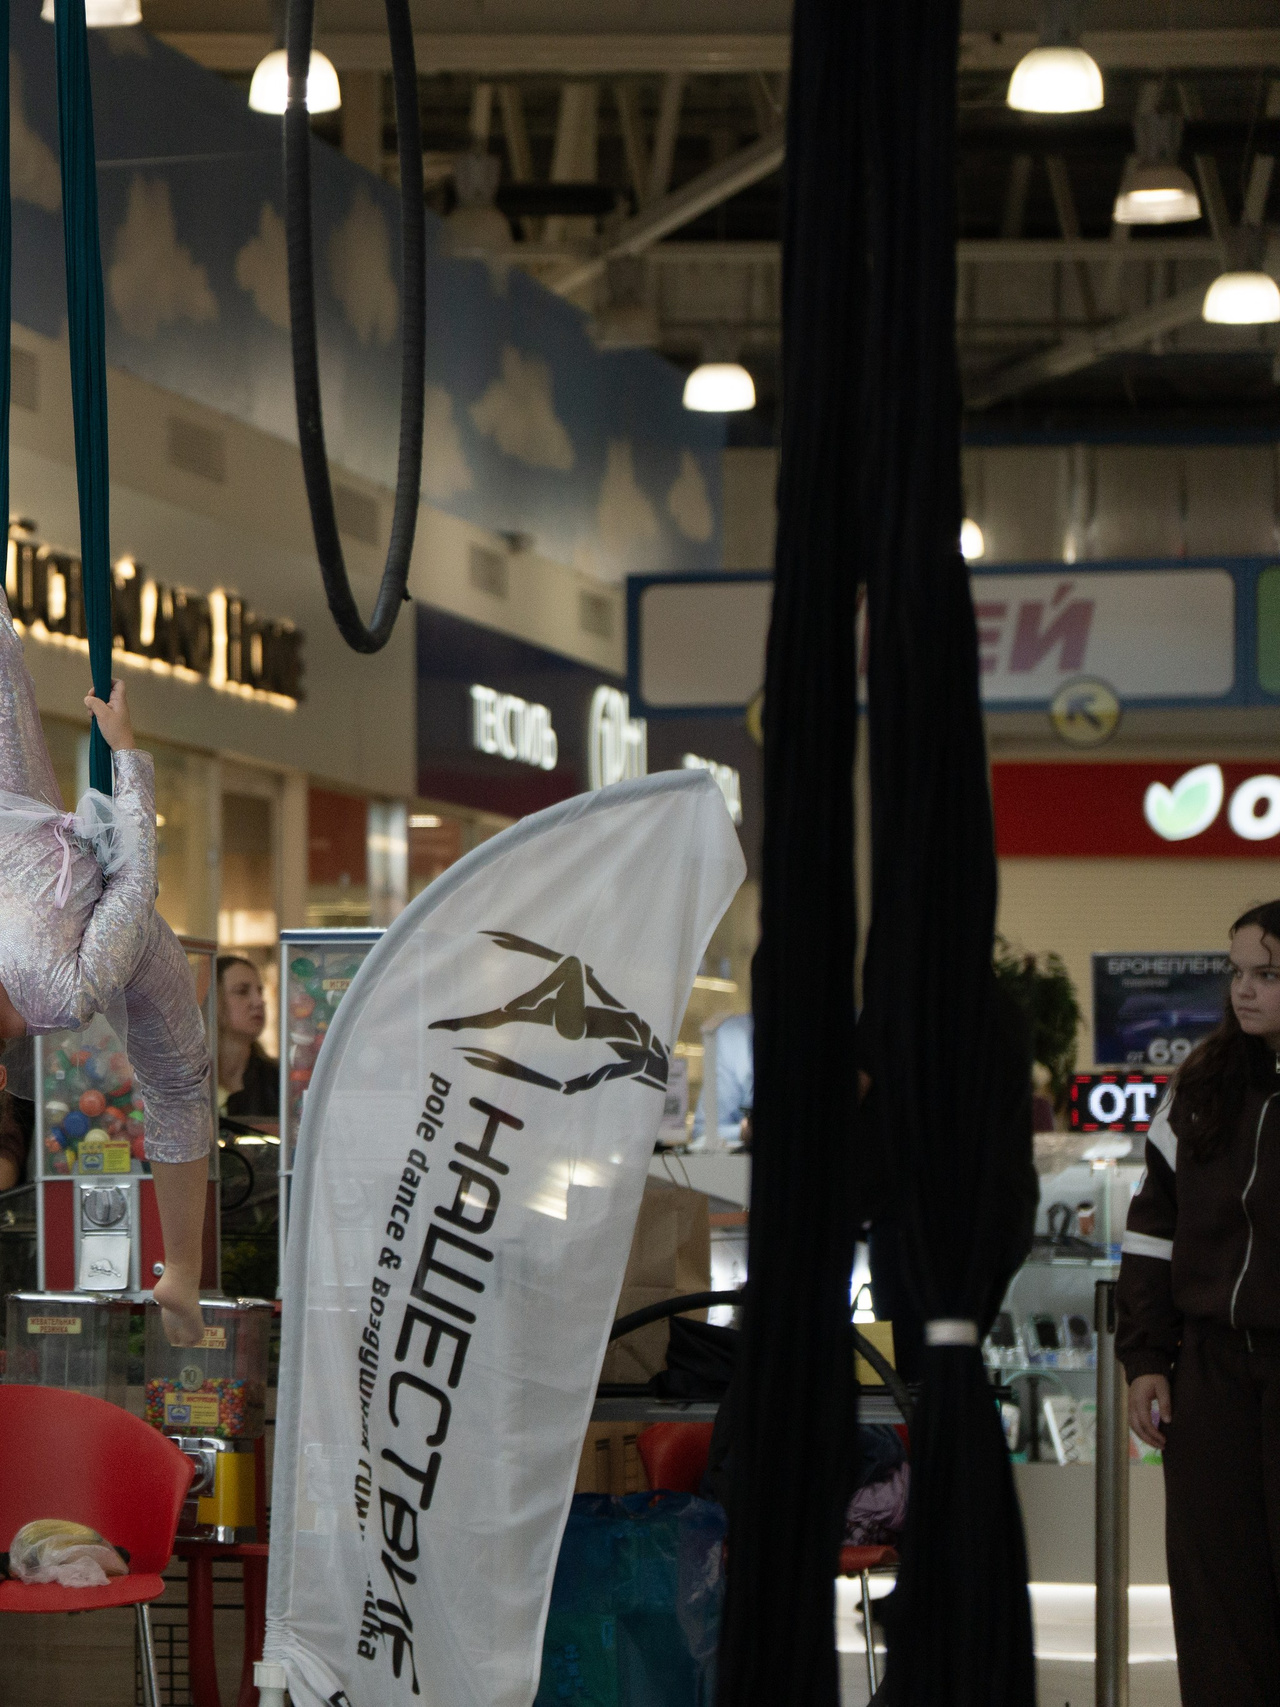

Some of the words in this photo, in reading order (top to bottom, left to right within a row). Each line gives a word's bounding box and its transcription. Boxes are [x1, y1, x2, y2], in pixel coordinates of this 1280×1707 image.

[416, 1072, 452, 1143] pole
[386, 1149, 430, 1242] dance
[378, 1247, 402, 1271] &
[378, 1096, 525, 1696] НАШЕСТВИЕ
